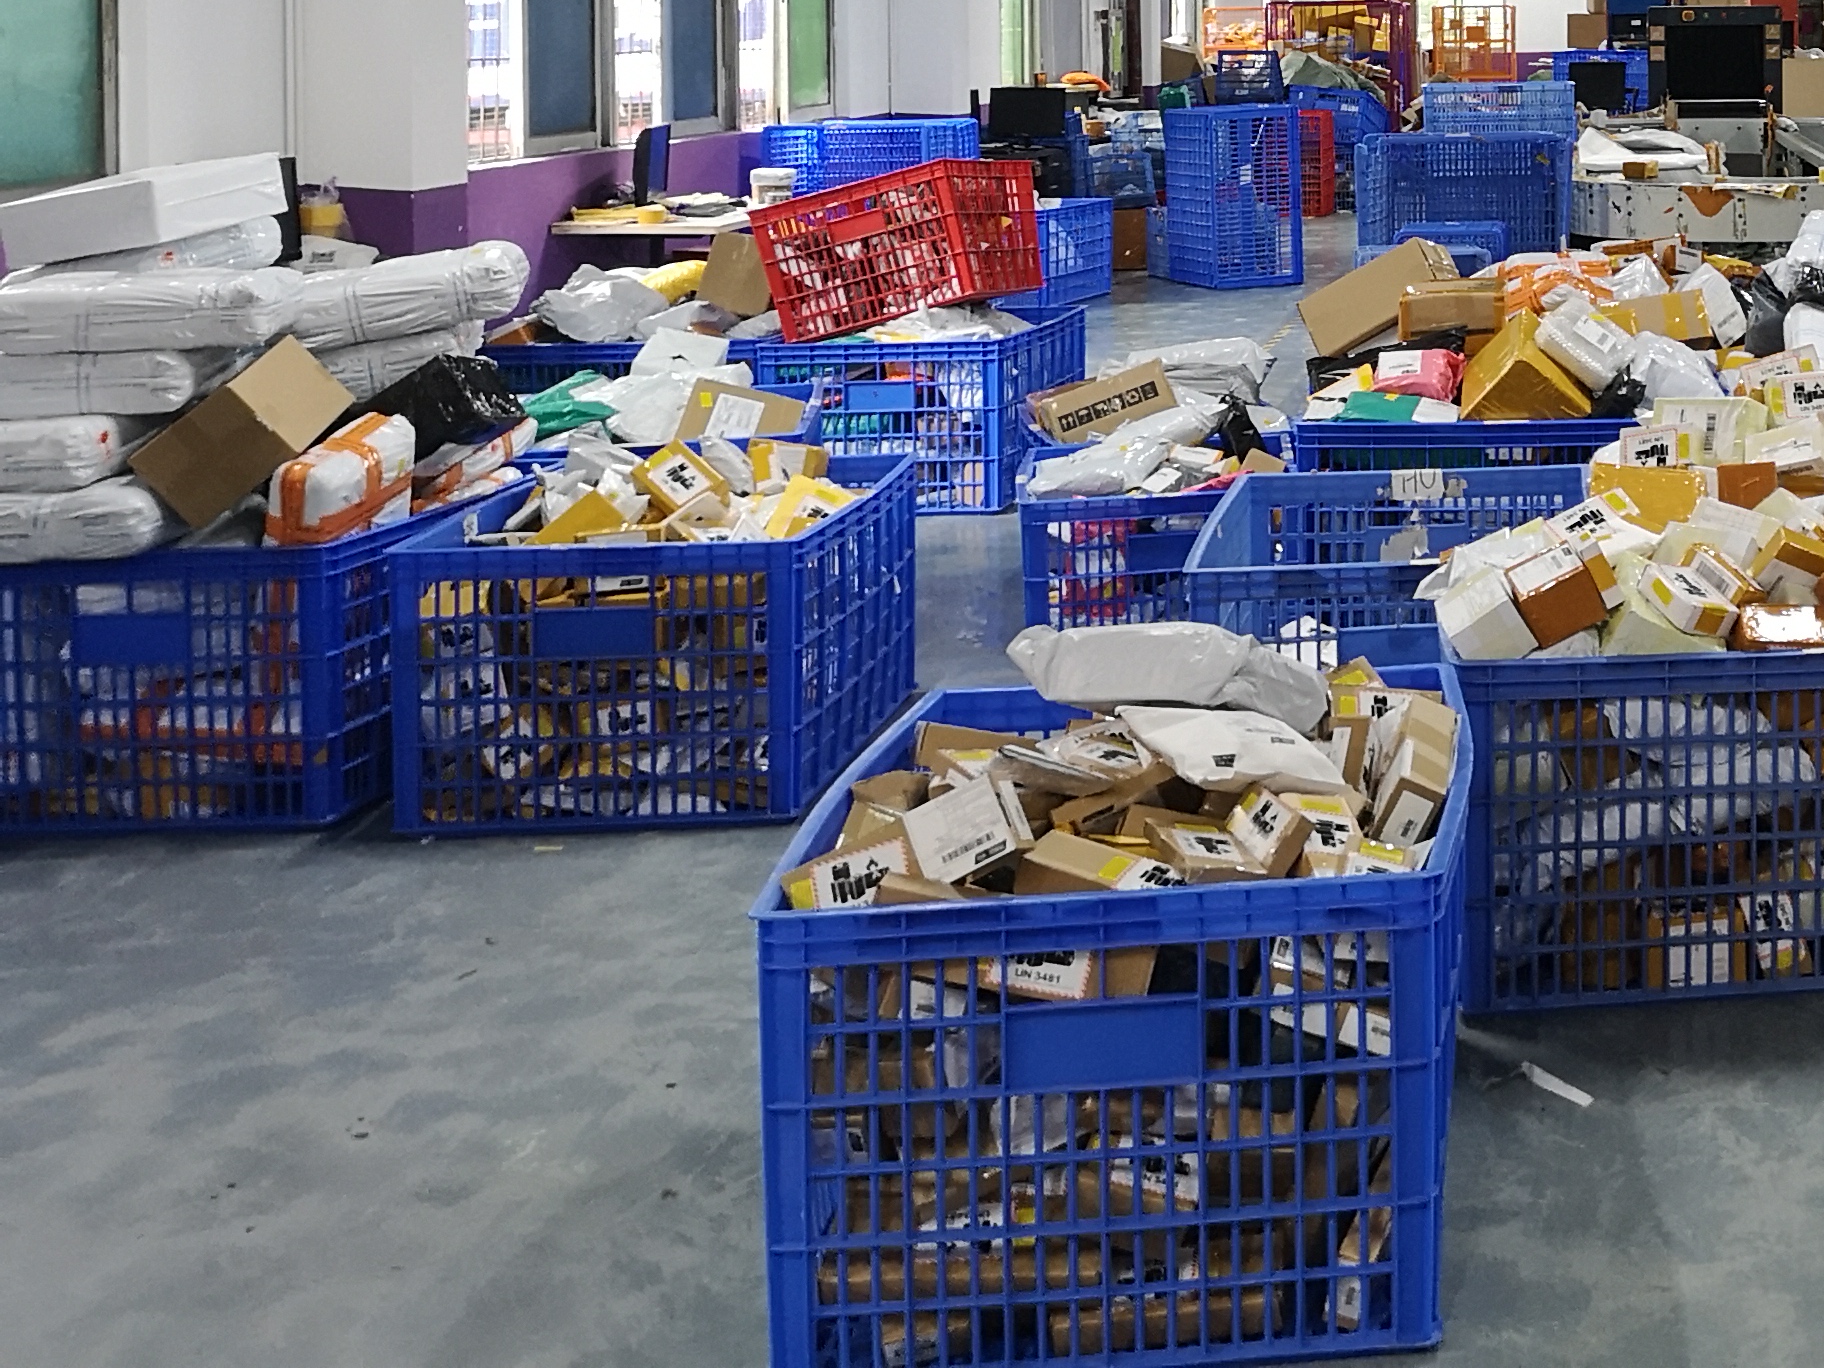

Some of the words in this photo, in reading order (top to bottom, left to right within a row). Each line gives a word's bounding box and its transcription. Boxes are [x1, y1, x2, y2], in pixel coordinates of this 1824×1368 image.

[1402, 470, 1437, 493] HU
[1014, 967, 1032, 979] UN
[1036, 970, 1062, 984] 3481
